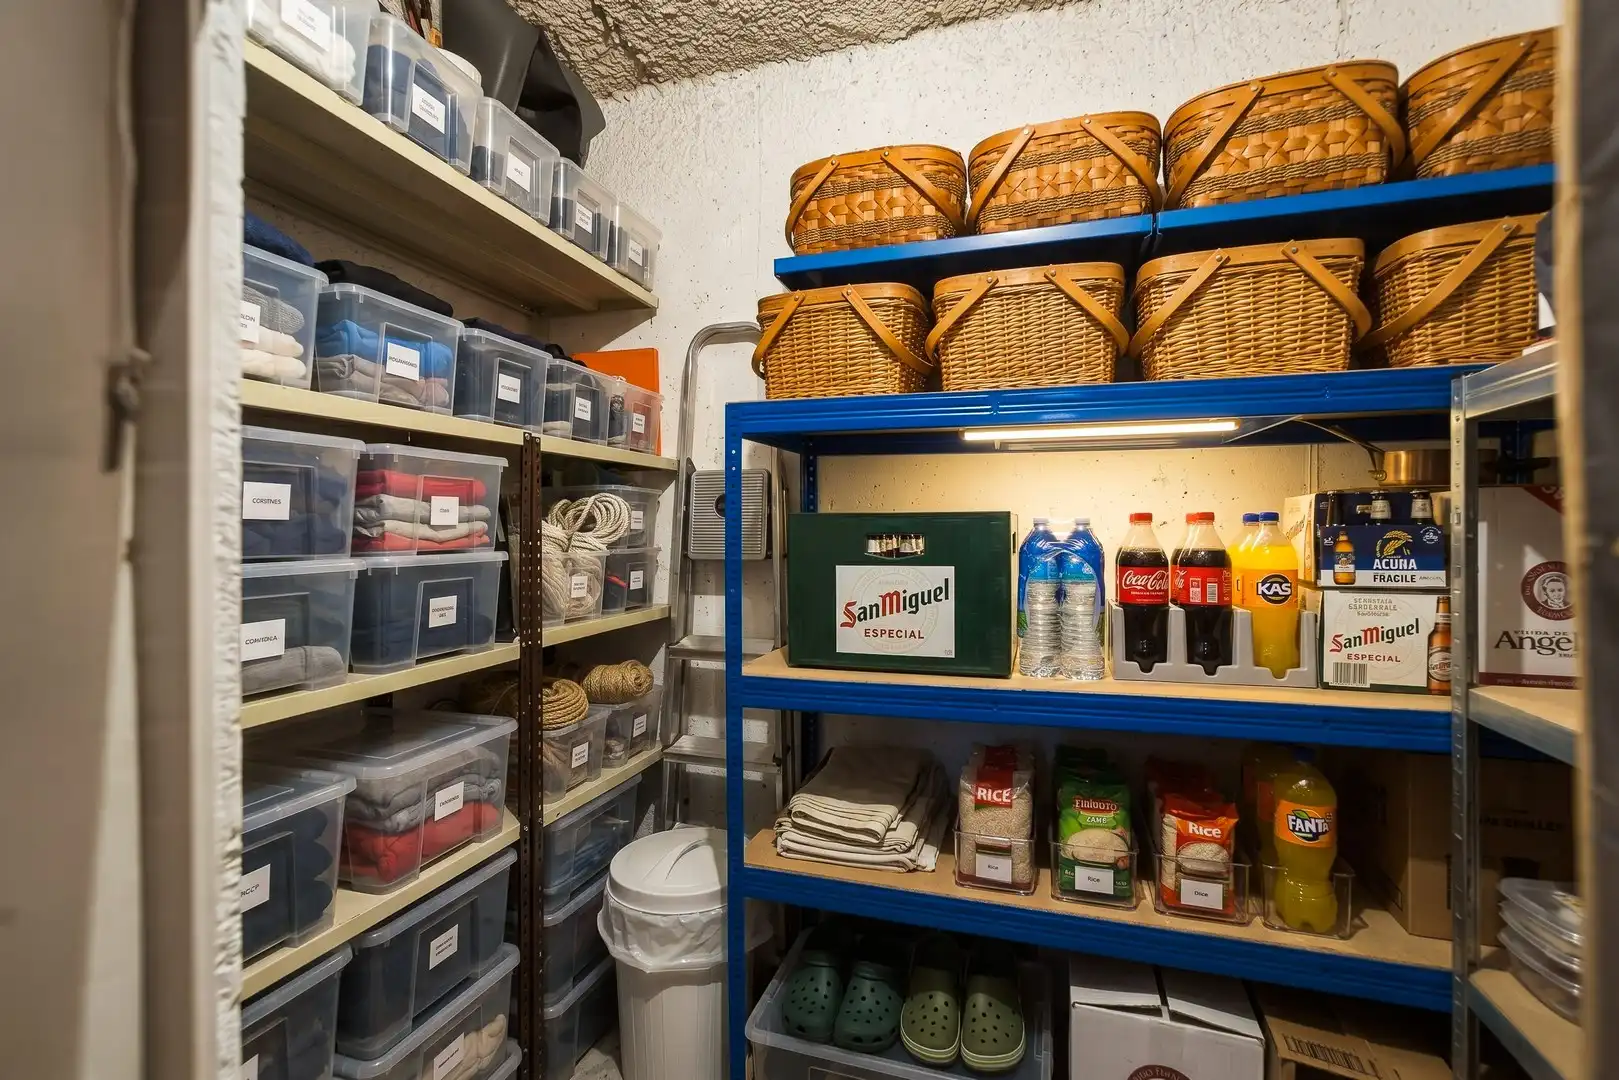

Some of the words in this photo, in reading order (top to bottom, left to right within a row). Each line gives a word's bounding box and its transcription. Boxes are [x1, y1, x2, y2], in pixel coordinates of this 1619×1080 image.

[1257, 582, 1292, 596] KAS
[864, 628, 925, 640] ESPECIAL
[1346, 653, 1401, 663] ESPECIAL
[977, 786, 1012, 803] RICE
[1287, 814, 1330, 833] FANTA
